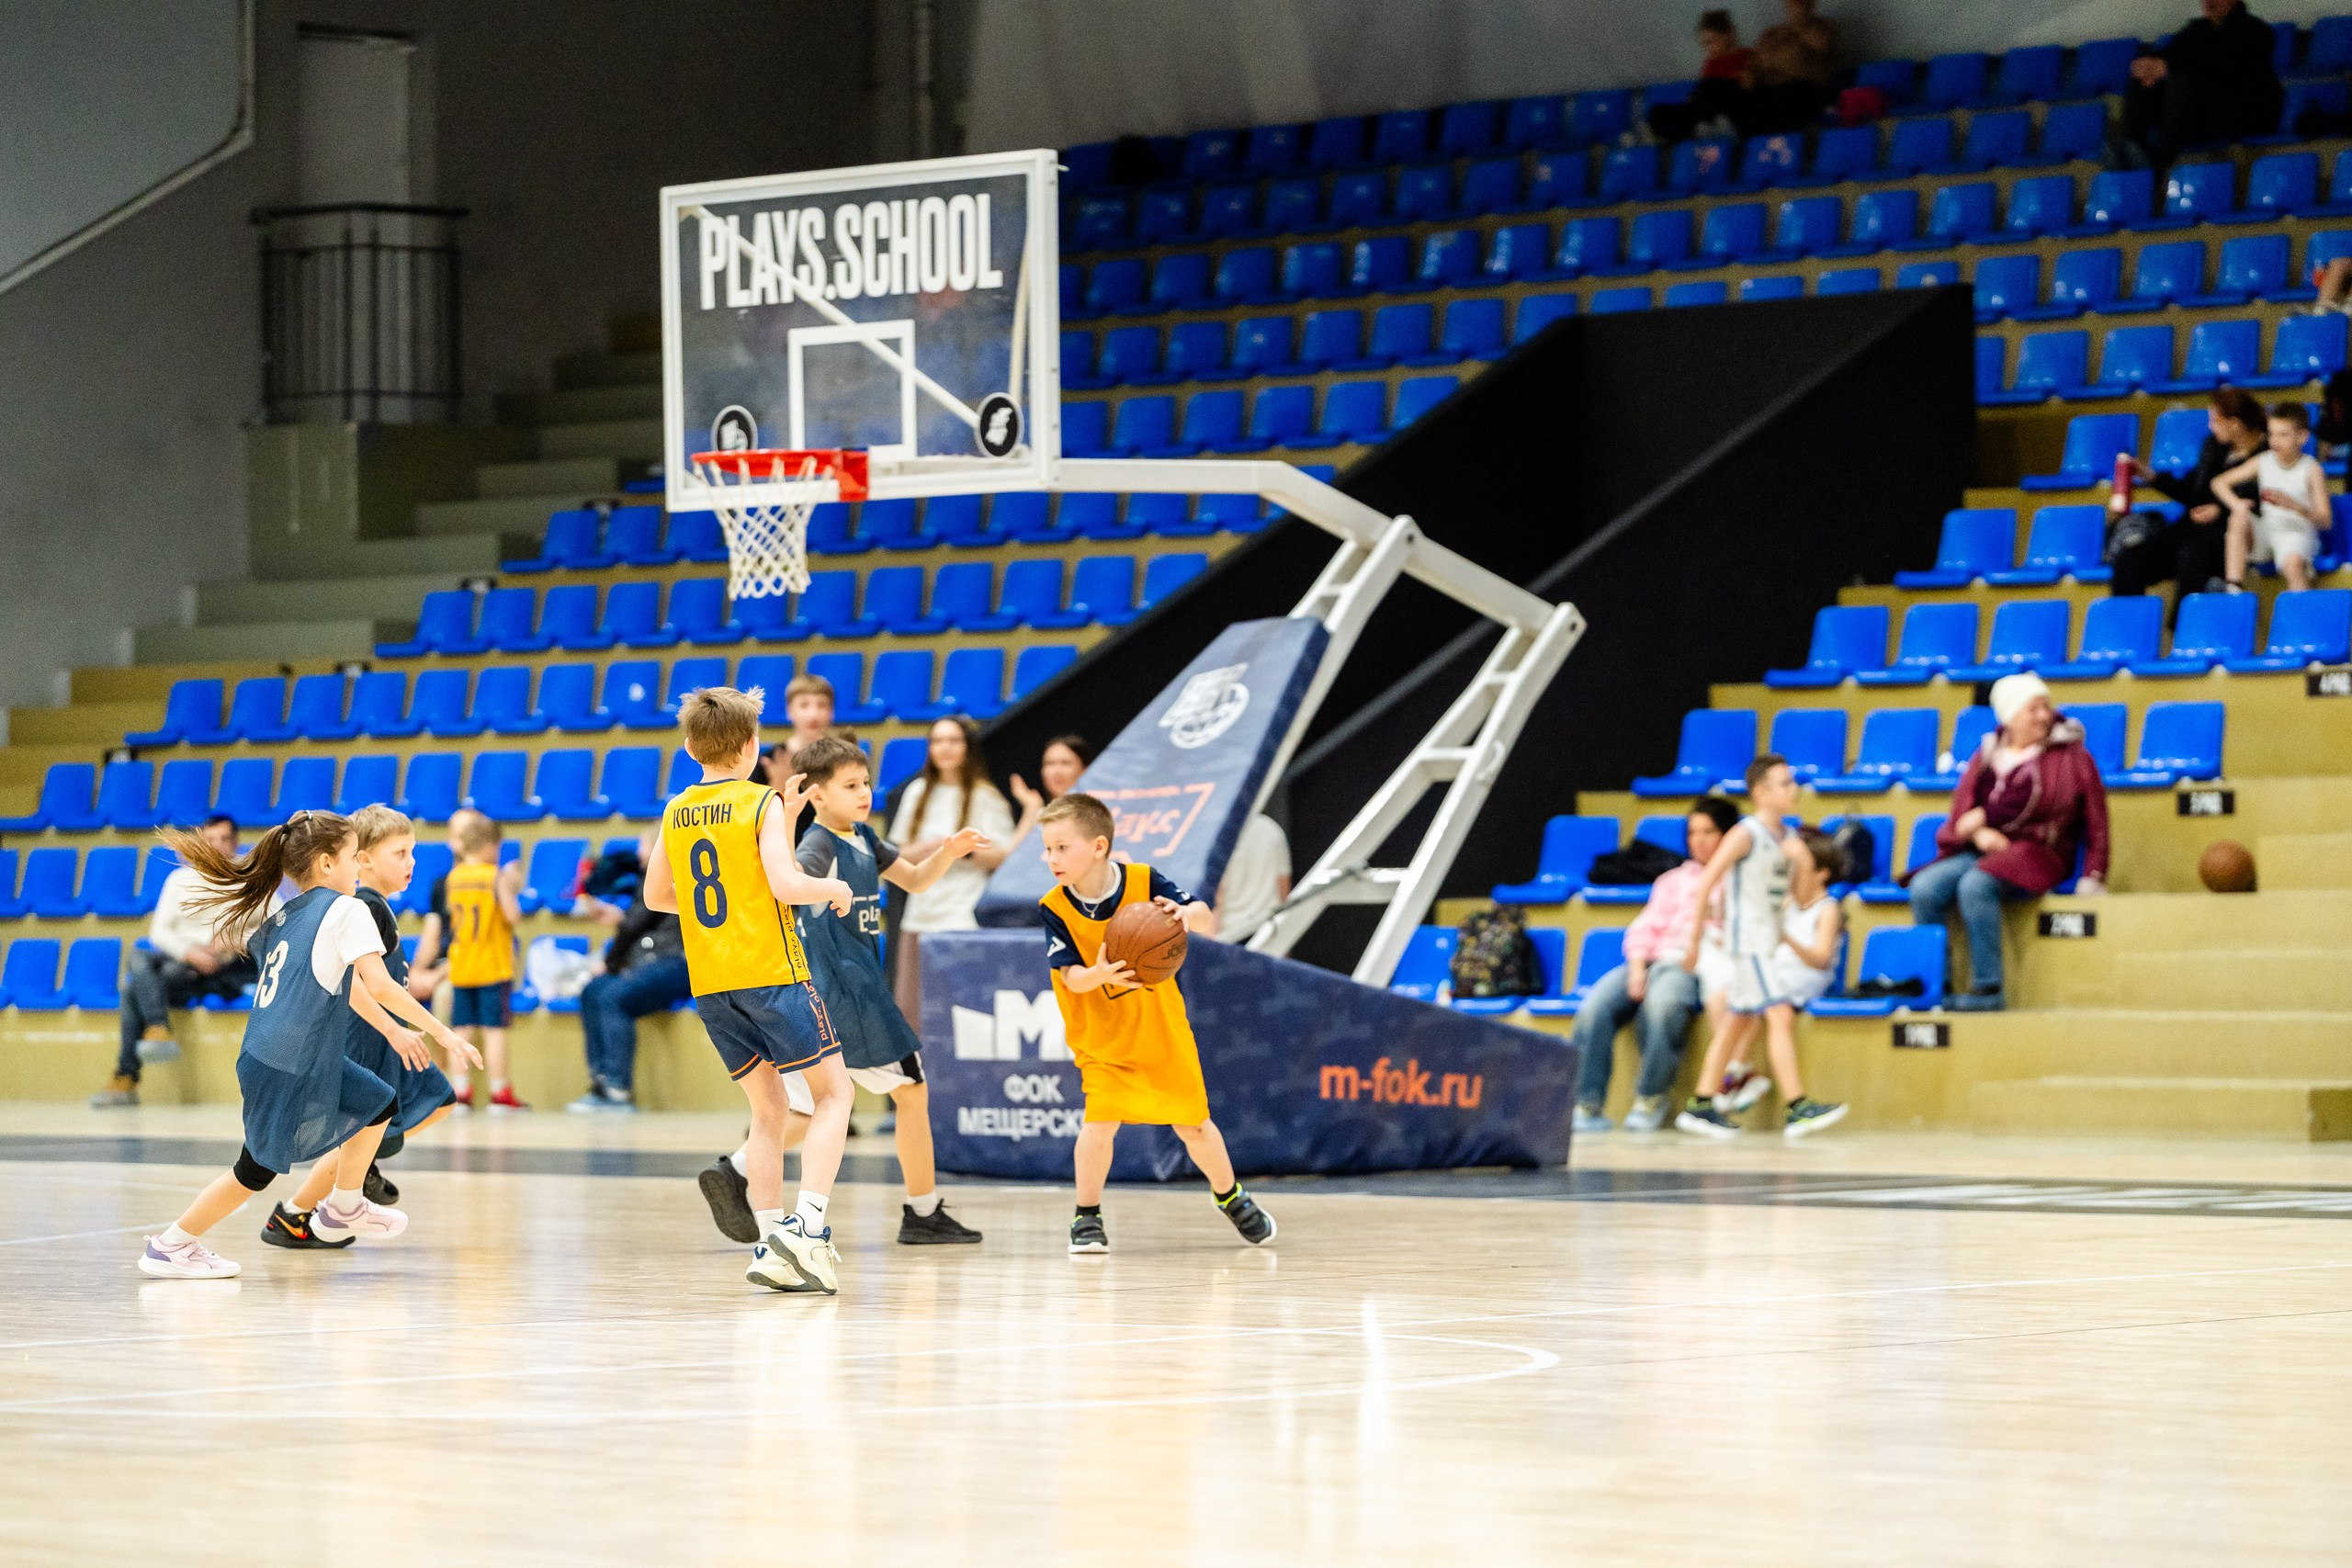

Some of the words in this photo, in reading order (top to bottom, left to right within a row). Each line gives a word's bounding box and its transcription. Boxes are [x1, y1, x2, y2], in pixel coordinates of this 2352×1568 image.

[700, 194, 1003, 310] PLAYS.SCHOOL
[673, 803, 732, 829] КОСТИН
[690, 838, 728, 929] 8
[1002, 1073, 1065, 1103] ФОК
[1319, 1056, 1484, 1108] m-fok.ru
[957, 1106, 1085, 1142] МЕЩЕРСК
